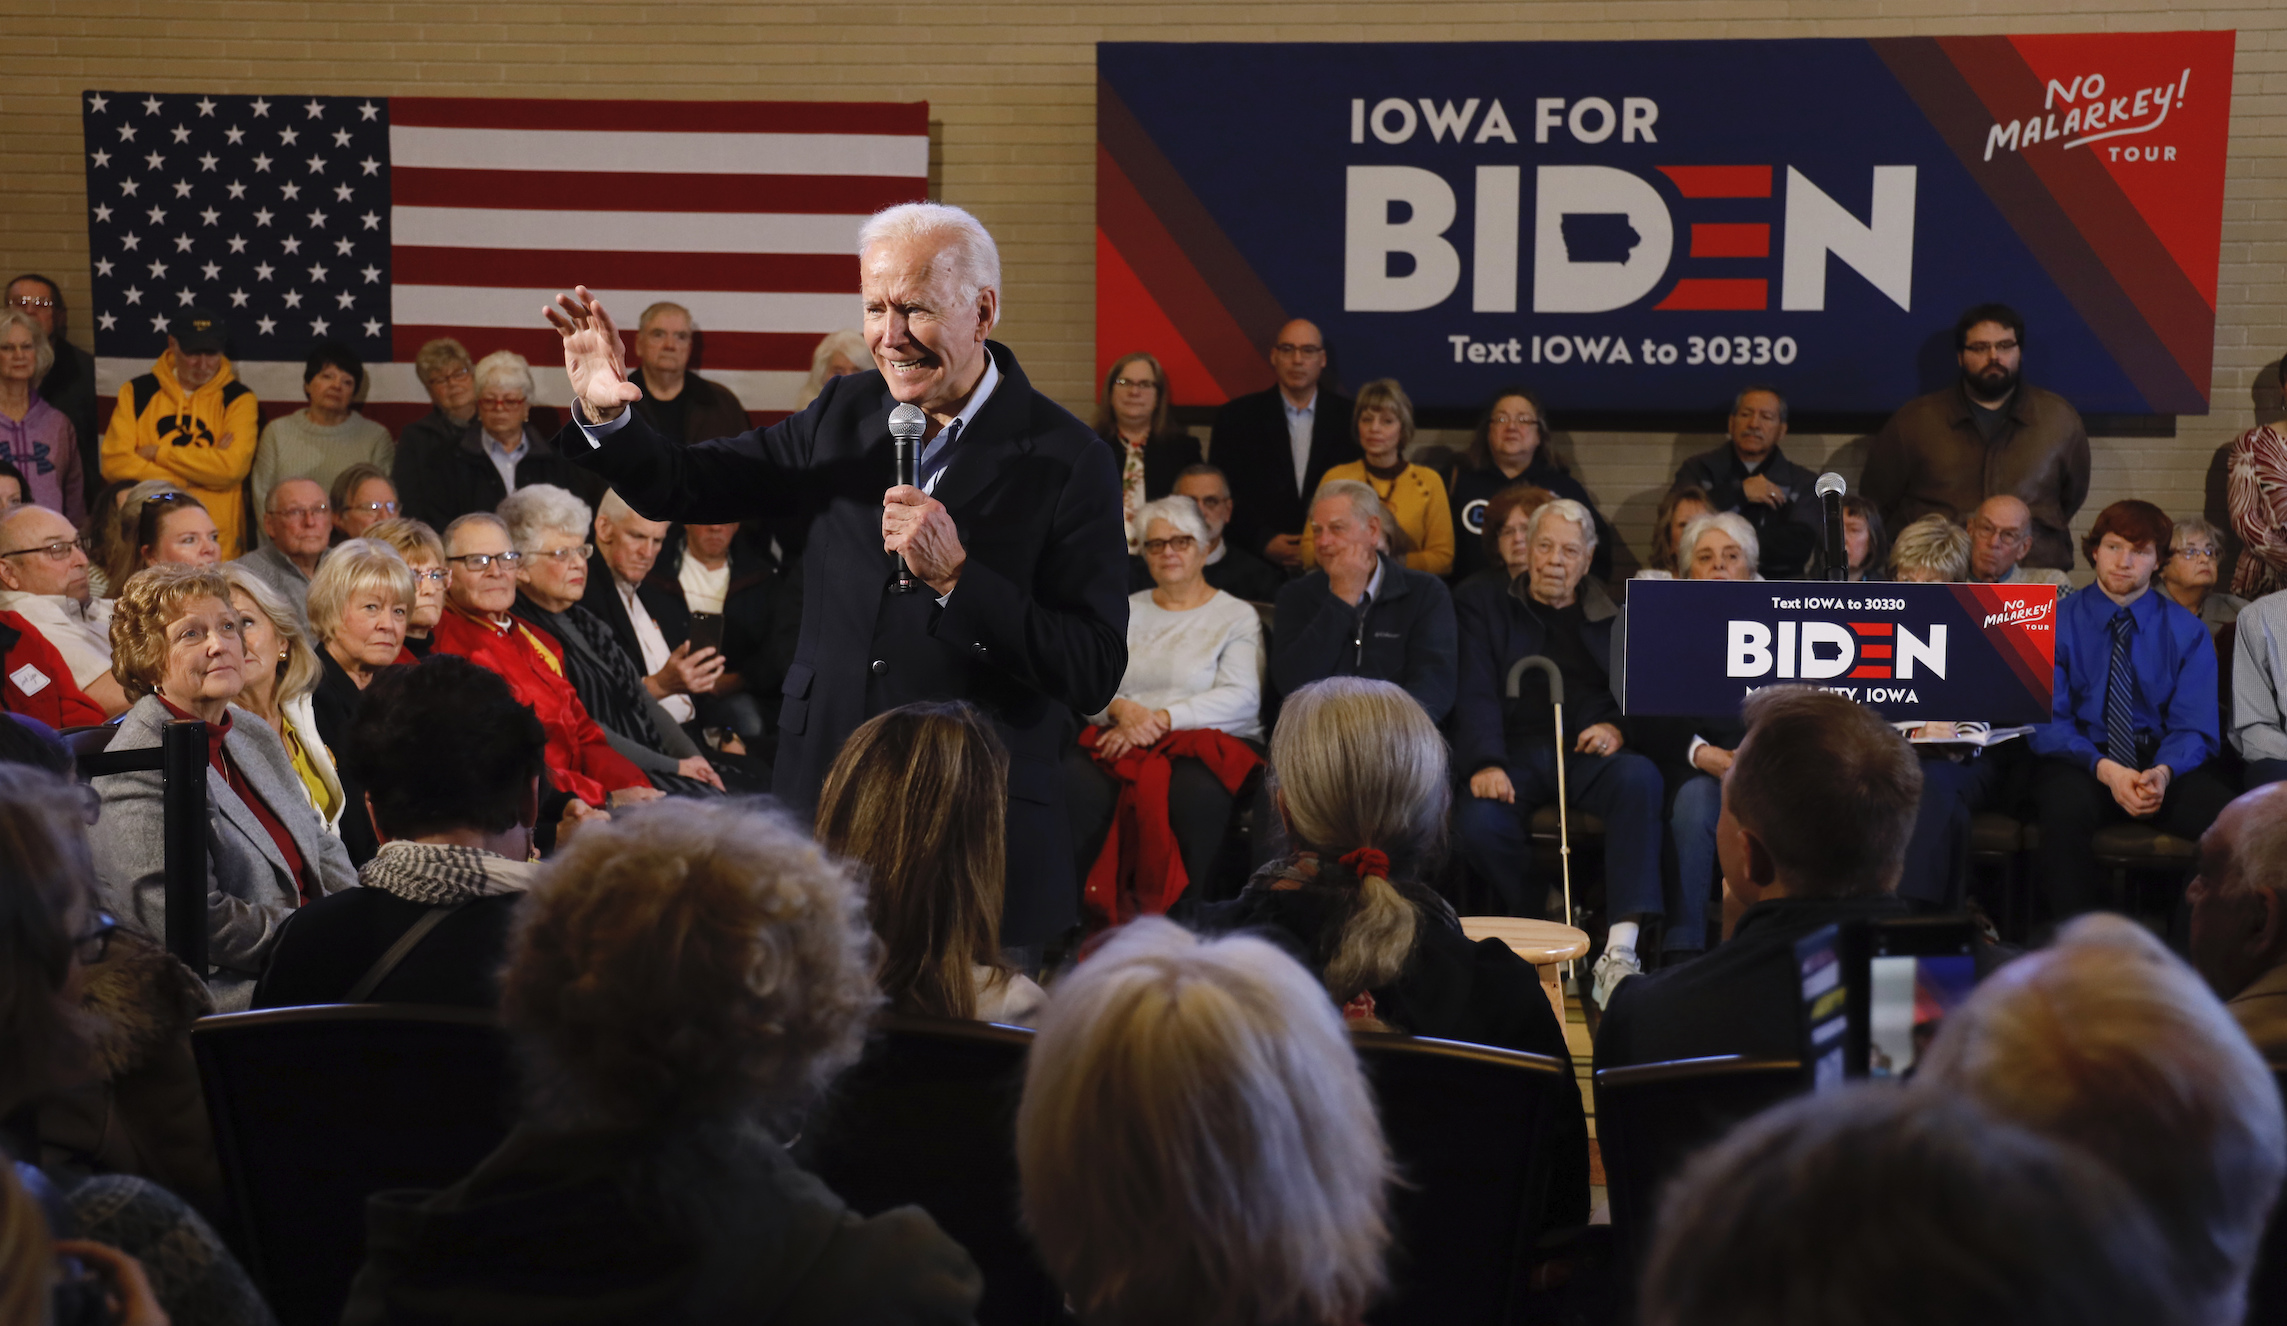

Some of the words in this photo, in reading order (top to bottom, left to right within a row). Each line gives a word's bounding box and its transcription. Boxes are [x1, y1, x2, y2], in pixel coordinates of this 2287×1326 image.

[2045, 73, 2106, 110] NO
[1351, 97, 1518, 144] IOWA
[1535, 96, 1659, 144] FOR
[1983, 67, 2191, 162] MALARKEY!
[2108, 146, 2177, 162] TOUR
[1344, 164, 1917, 313] BIDEN
[1448, 335, 1522, 364] Text
[1531, 335, 1633, 365] IOWA
[1642, 338, 1678, 365] to
[1686, 335, 1799, 366] 30330
[1771, 596, 1801, 609] Text
[1804, 597, 1845, 610] IOWA
[1847, 598, 1862, 610] to
[1864, 598, 1906, 611] 30330
[1983, 598, 2053, 629] MALARKEY!
[2003, 599, 2025, 612] NO
[1726, 620, 1947, 680] BIDEN
[1866, 687, 1919, 704] IOWA
